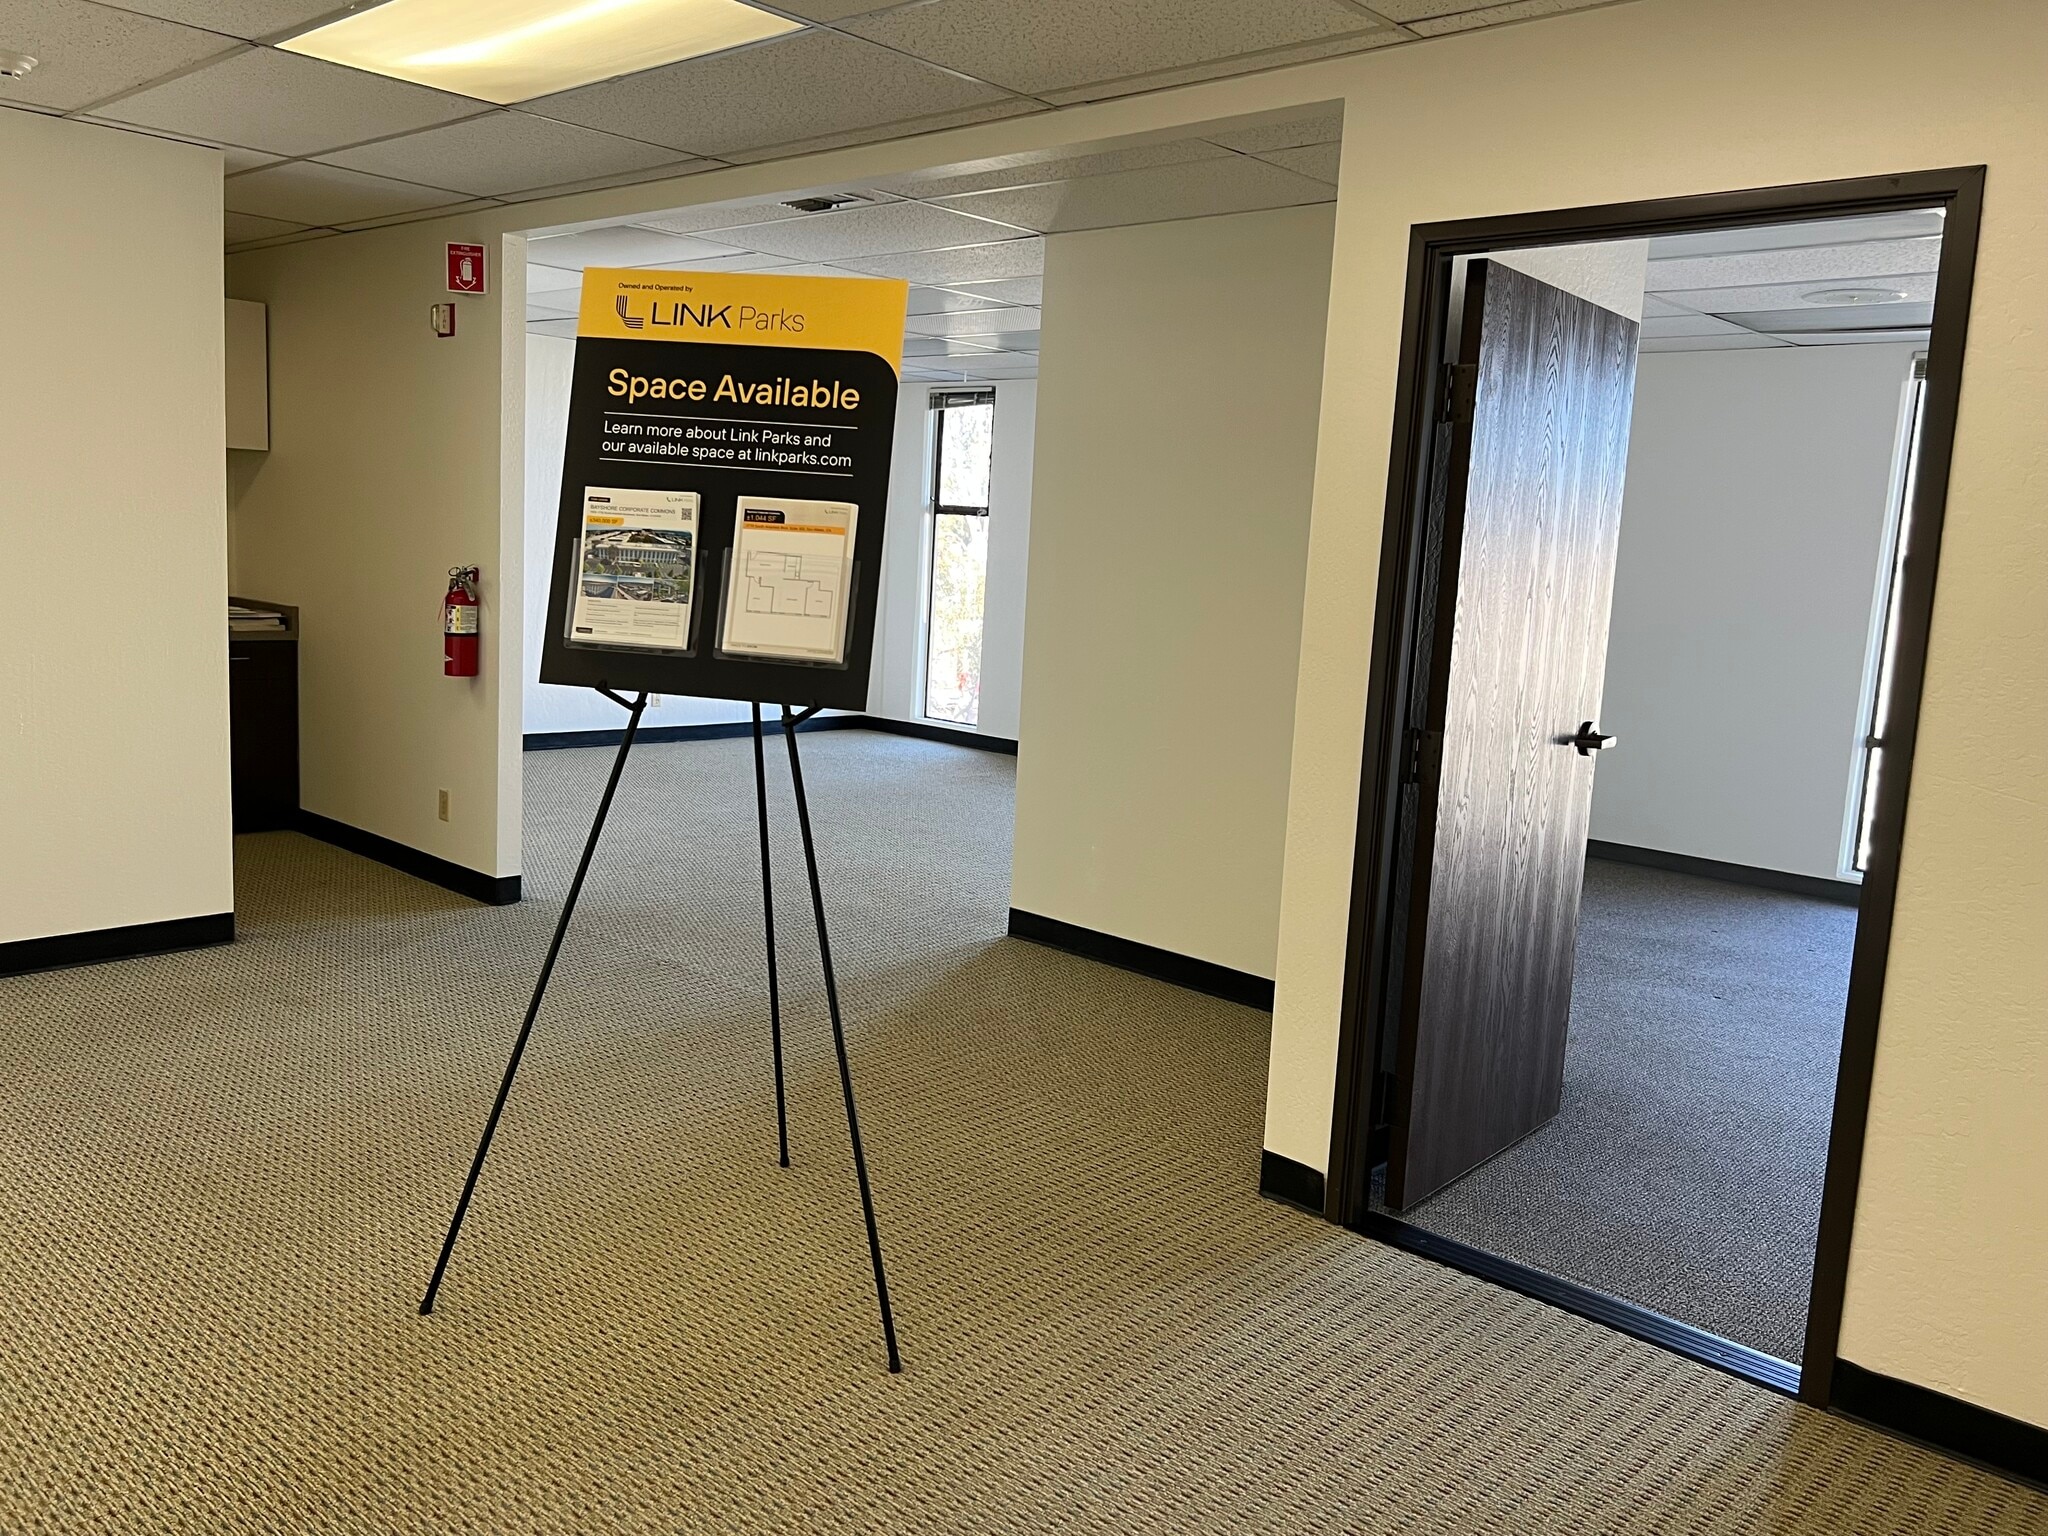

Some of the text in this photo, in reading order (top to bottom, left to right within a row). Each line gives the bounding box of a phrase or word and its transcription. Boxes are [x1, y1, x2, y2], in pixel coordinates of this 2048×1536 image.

[618, 282, 641, 290] Owned
[654, 284, 684, 293] Operated
[651, 301, 805, 333] LINK Parks
[607, 367, 860, 410] Space Available
[603, 420, 832, 448] Learn more about Link Parks and
[602, 440, 852, 467] our available space at linkparks.com
